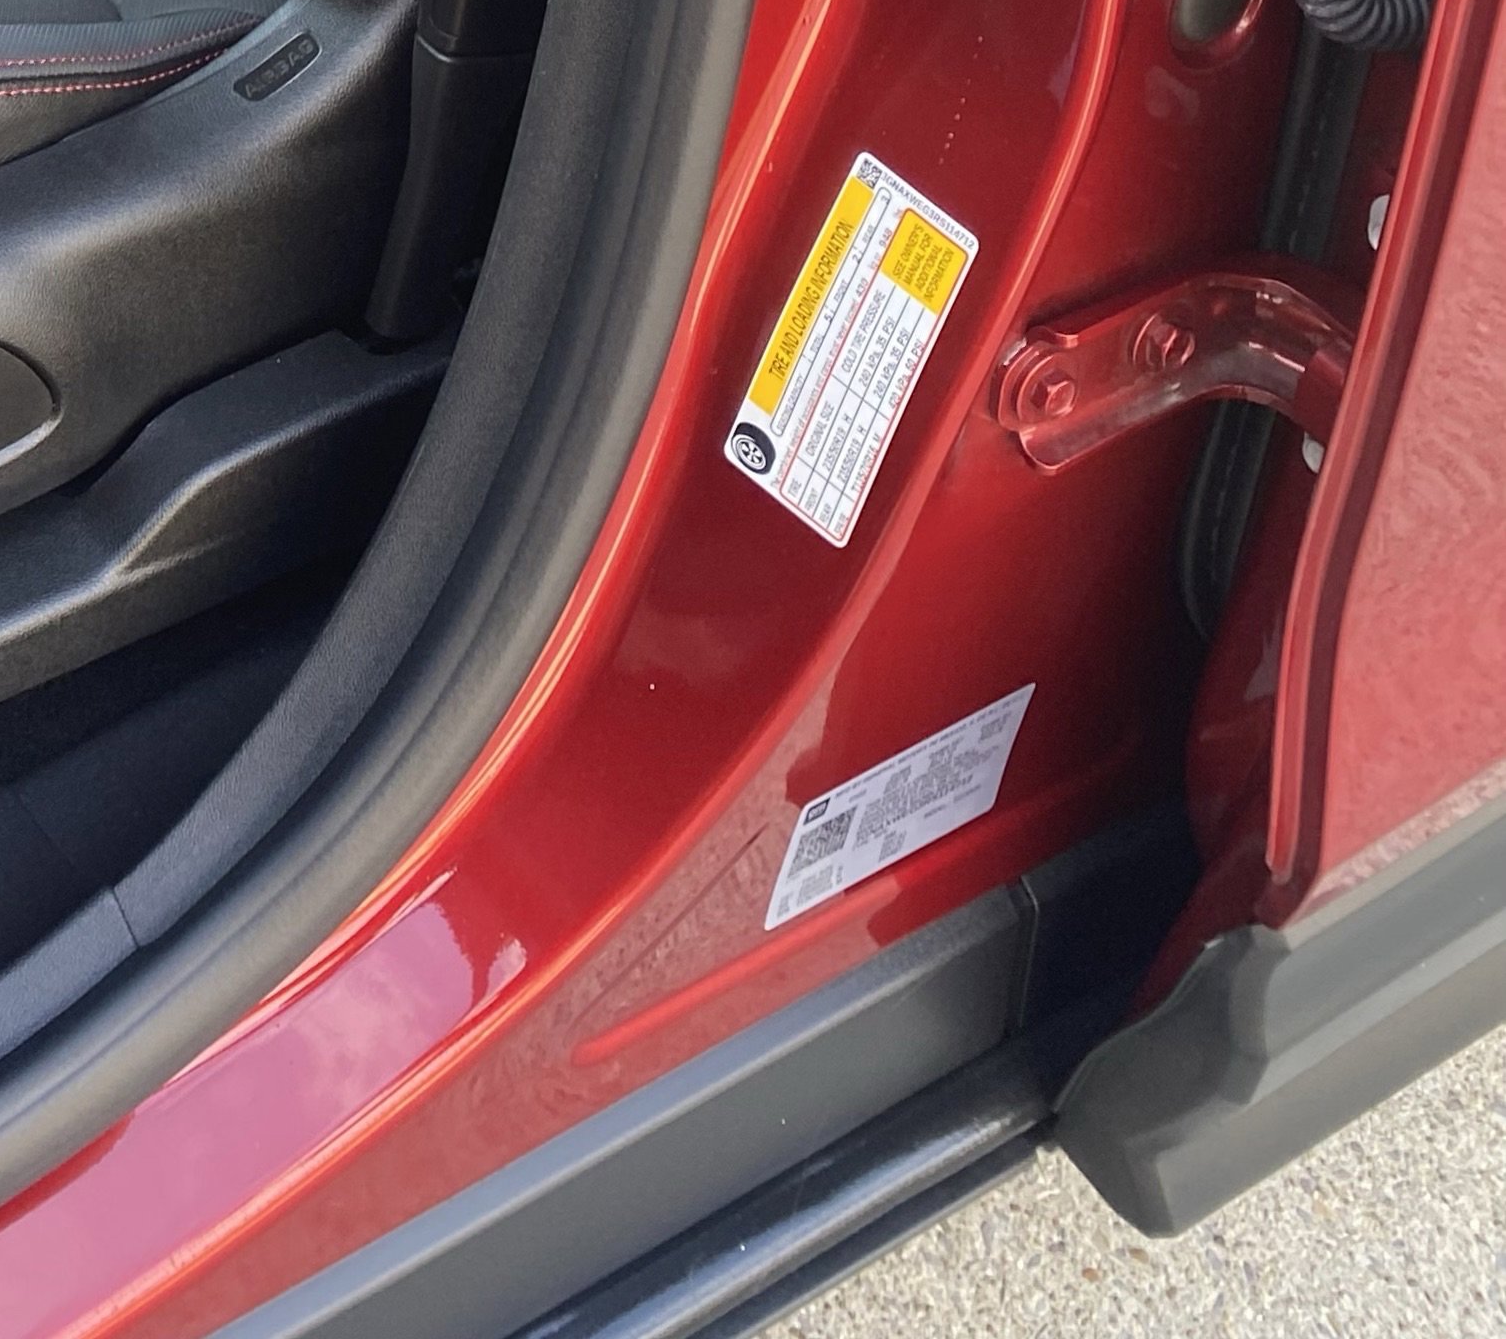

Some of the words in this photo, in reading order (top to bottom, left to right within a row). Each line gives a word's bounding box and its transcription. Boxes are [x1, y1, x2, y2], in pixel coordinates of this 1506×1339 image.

[809, 215, 854, 293] INFORMATION
[851, 252, 861, 263] 2
[918, 231, 933, 253] FOR
[788, 284, 821, 337] LOADING
[778, 329, 800, 359] AND
[841, 348, 858, 374] COLD
[859, 288, 885, 335] PRESSURE
[768, 351, 790, 382] TIRE
